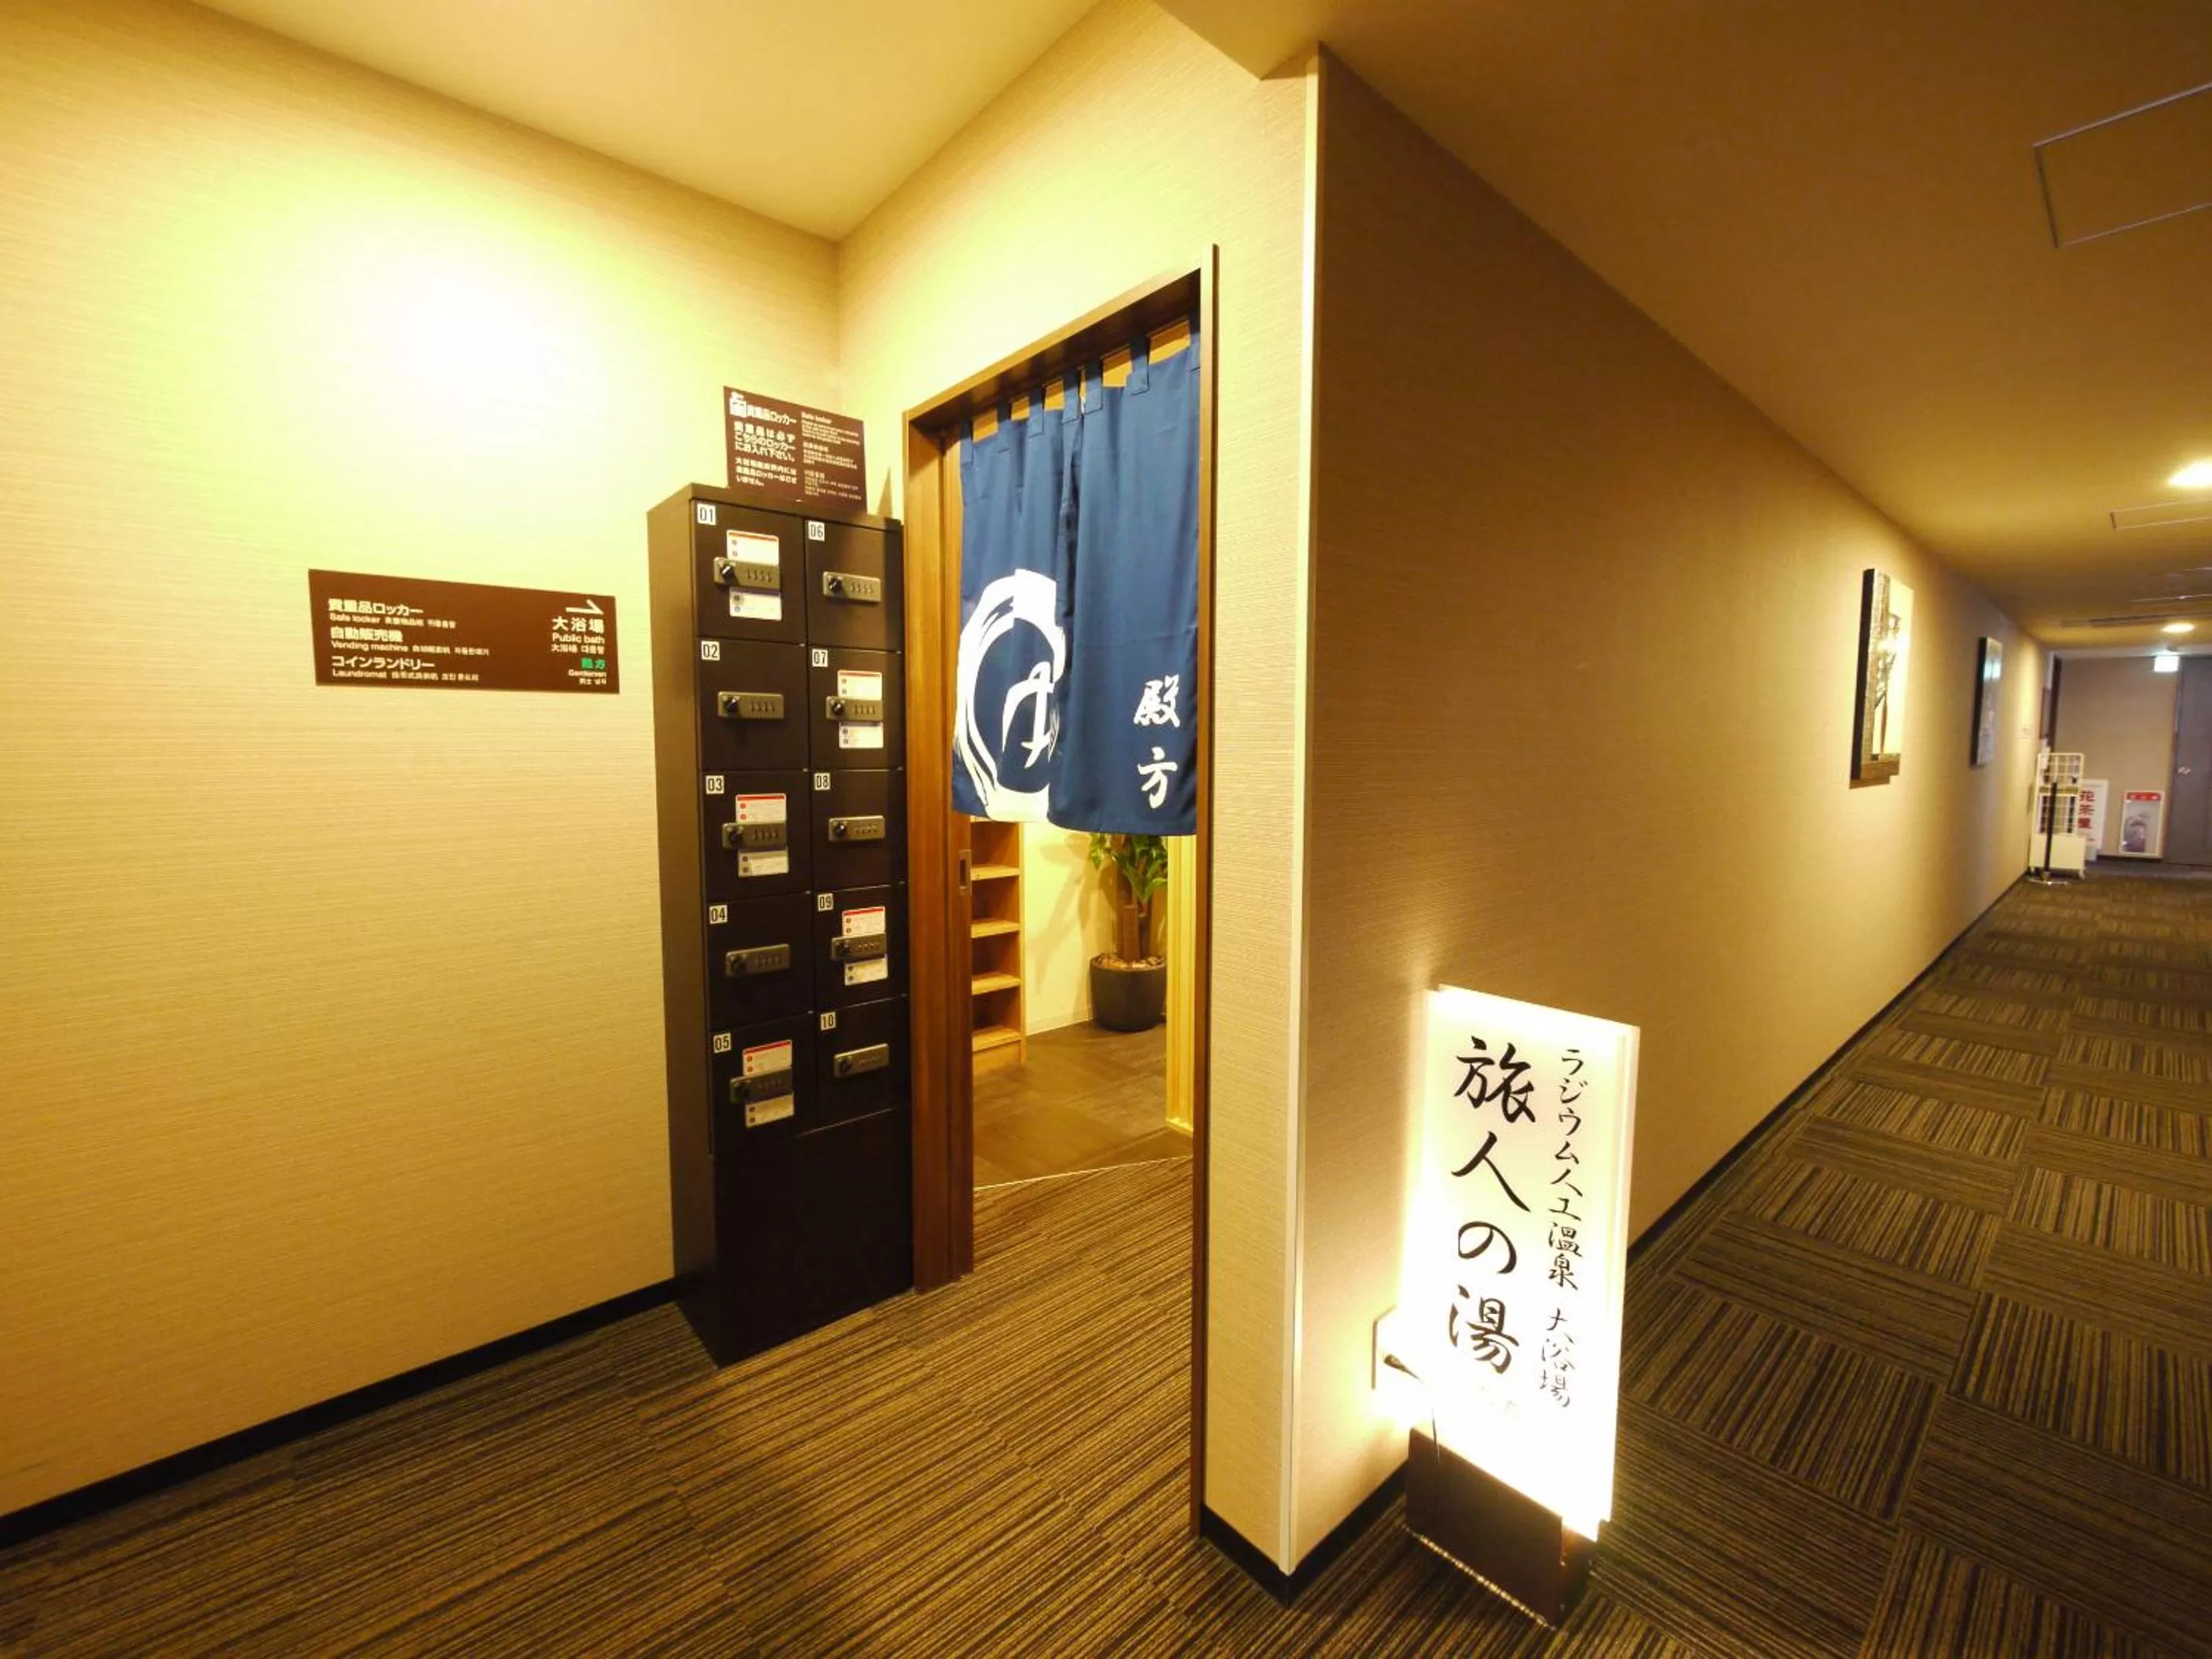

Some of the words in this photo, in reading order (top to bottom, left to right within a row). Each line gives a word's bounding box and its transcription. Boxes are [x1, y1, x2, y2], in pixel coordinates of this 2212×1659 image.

[699, 507, 714, 522] 01
[810, 525, 823, 538] 06
[551, 616, 604, 633] 大浴場
[552, 632, 581, 643] Public
[584, 635, 605, 644] bath
[703, 643, 718, 658] 02
[331, 655, 435, 670] コインランドリー
[813, 651, 826, 665] 07
[1133, 674, 1180, 808] 殿方
[708, 778, 723, 791] 03
[815, 775, 829, 788] 08
[819, 896, 832, 909] 09
[711, 908, 726, 921] 04
[822, 1016, 834, 1027] 10
[715, 1035, 730, 1049] 05
[1547, 1049, 1588, 1291] ラジウム人工温泉
[1449, 1036, 1537, 1375] 旅人の湯
[1539, 1307, 1576, 1408] 大浴場
